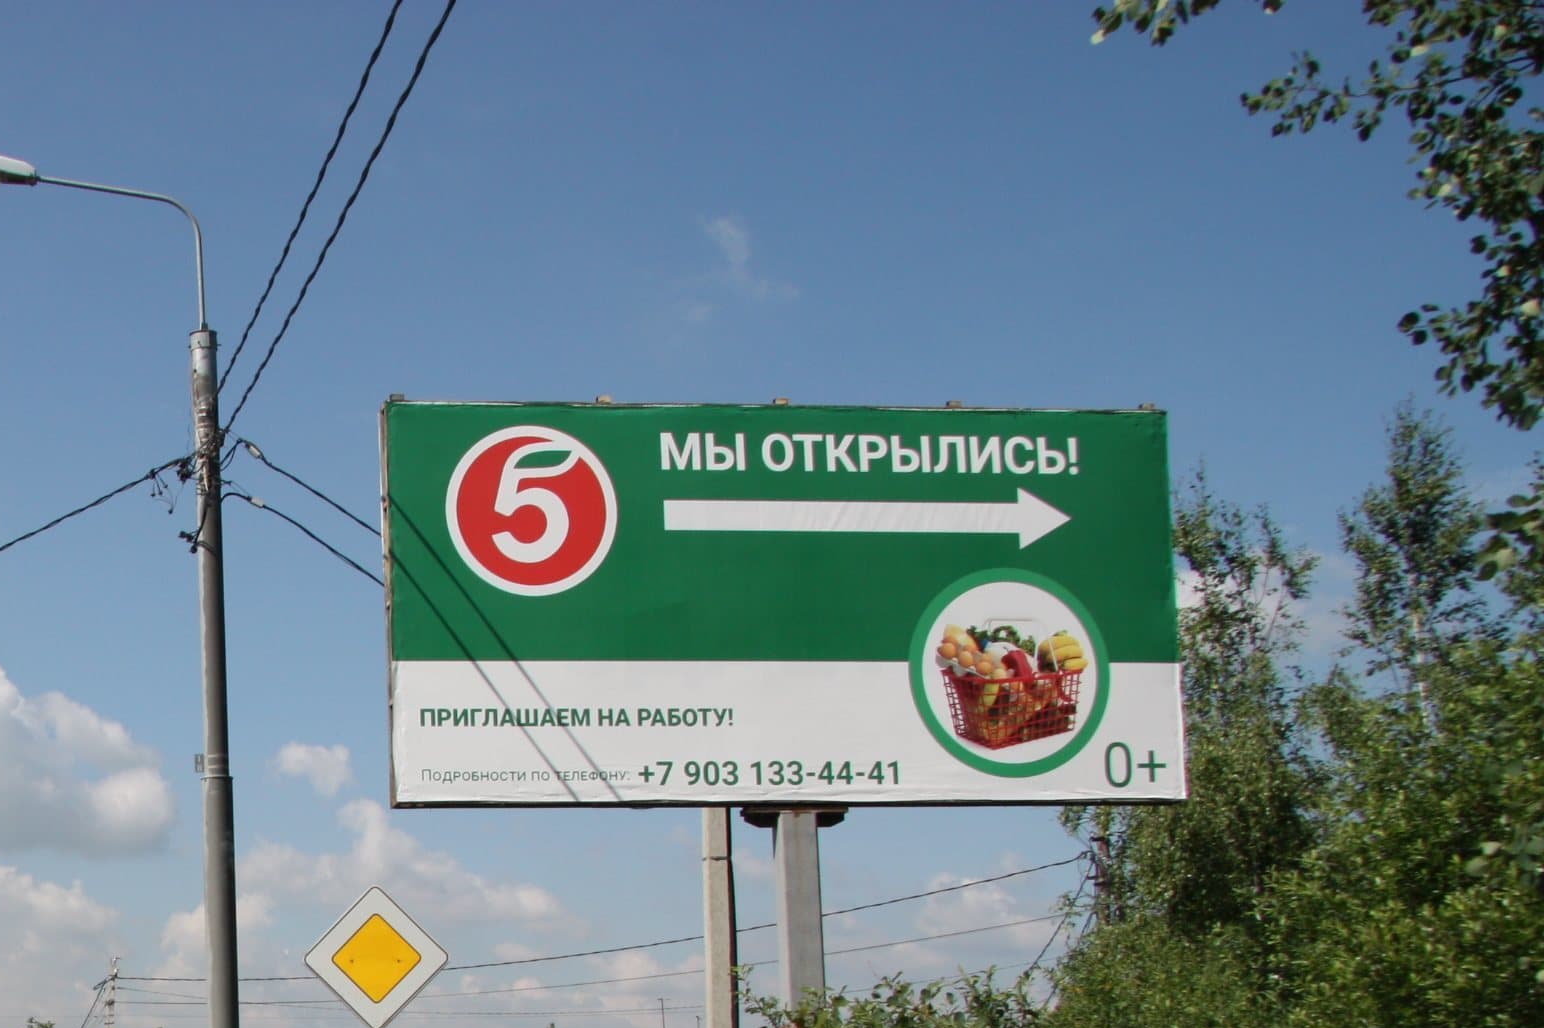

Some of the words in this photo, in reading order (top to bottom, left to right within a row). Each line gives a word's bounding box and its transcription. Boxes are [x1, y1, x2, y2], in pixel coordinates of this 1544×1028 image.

[659, 432, 747, 472] МЫ
[760, 432, 1080, 476] ОТКРЫЛИСЬ!
[491, 440, 582, 564] 5
[419, 707, 591, 728] ПРИГЛАШАЕМ
[597, 707, 632, 728] НА
[636, 707, 735, 728] РАБОТУ!
[638, 760, 674, 787] +7
[683, 760, 740, 787] 903
[750, 760, 901, 786] 133-44-41
[1103, 741, 1168, 788] 0+
